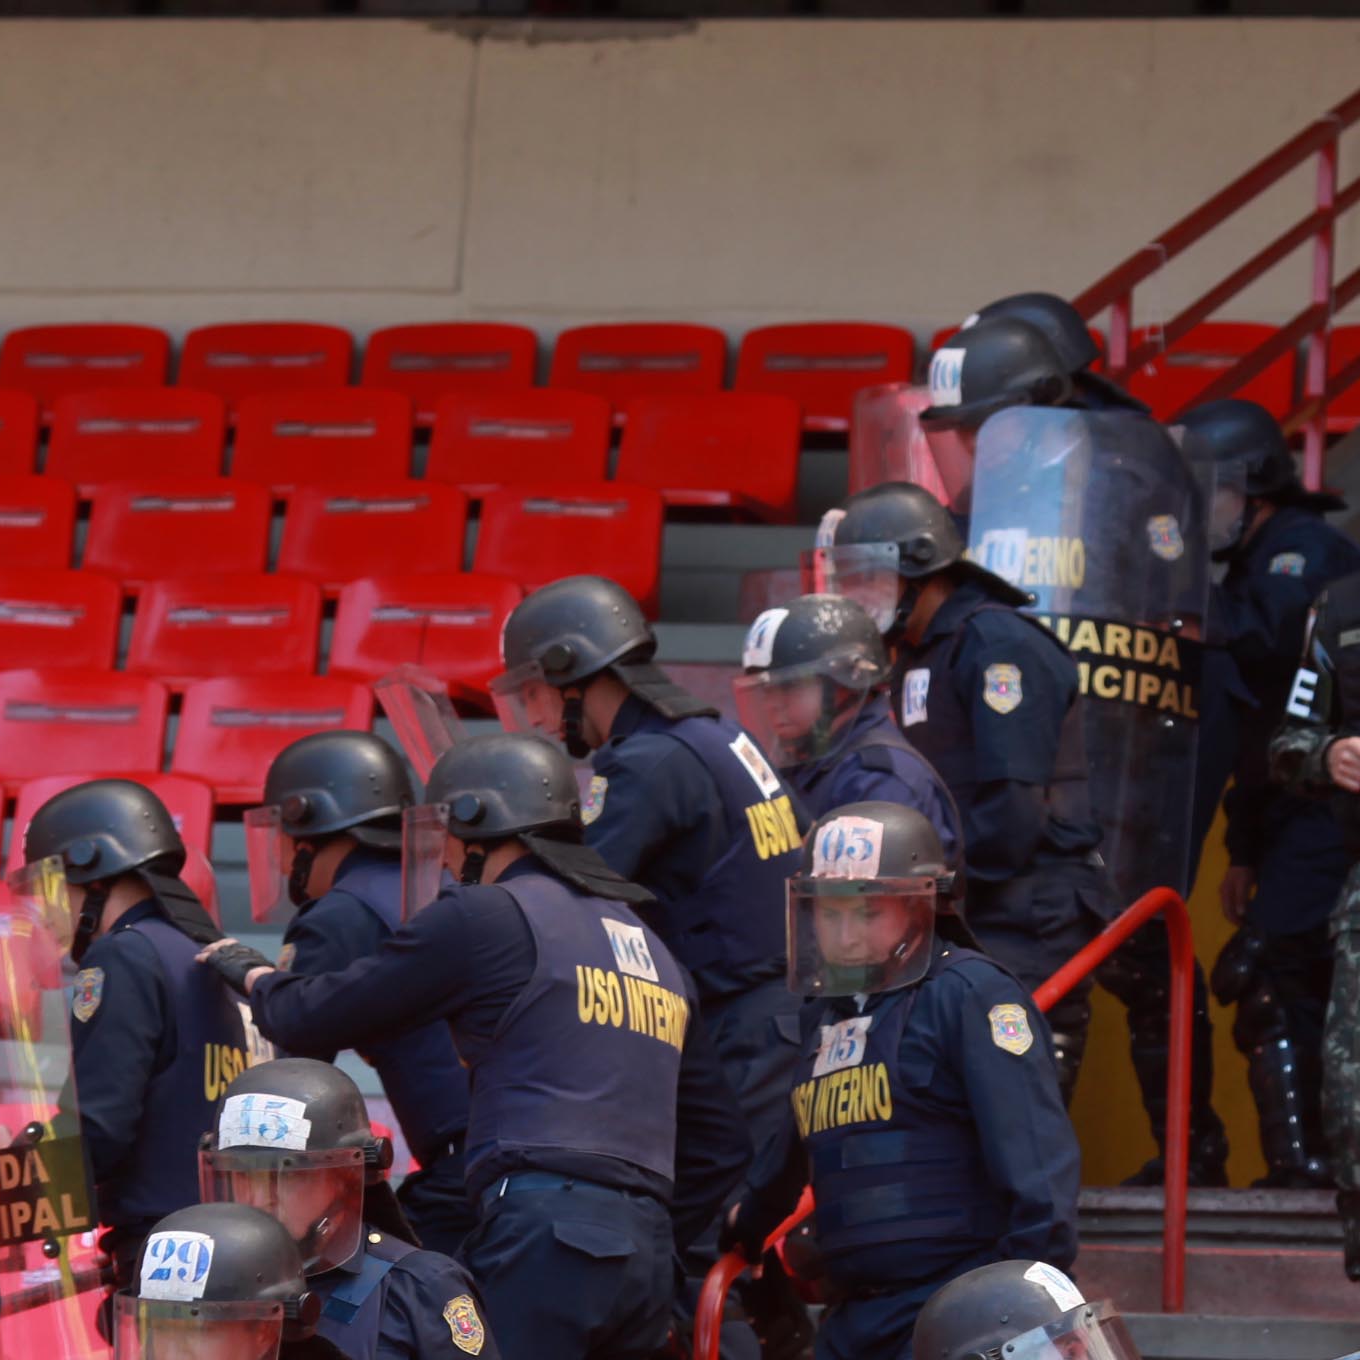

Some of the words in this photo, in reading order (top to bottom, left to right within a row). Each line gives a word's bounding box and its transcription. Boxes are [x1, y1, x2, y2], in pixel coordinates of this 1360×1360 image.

[821, 828, 874, 862] 05
[577, 965, 624, 1028] USO
[239, 1095, 290, 1141] 15
[813, 1062, 893, 1133] INTERNO
[147, 1238, 211, 1283] 29
